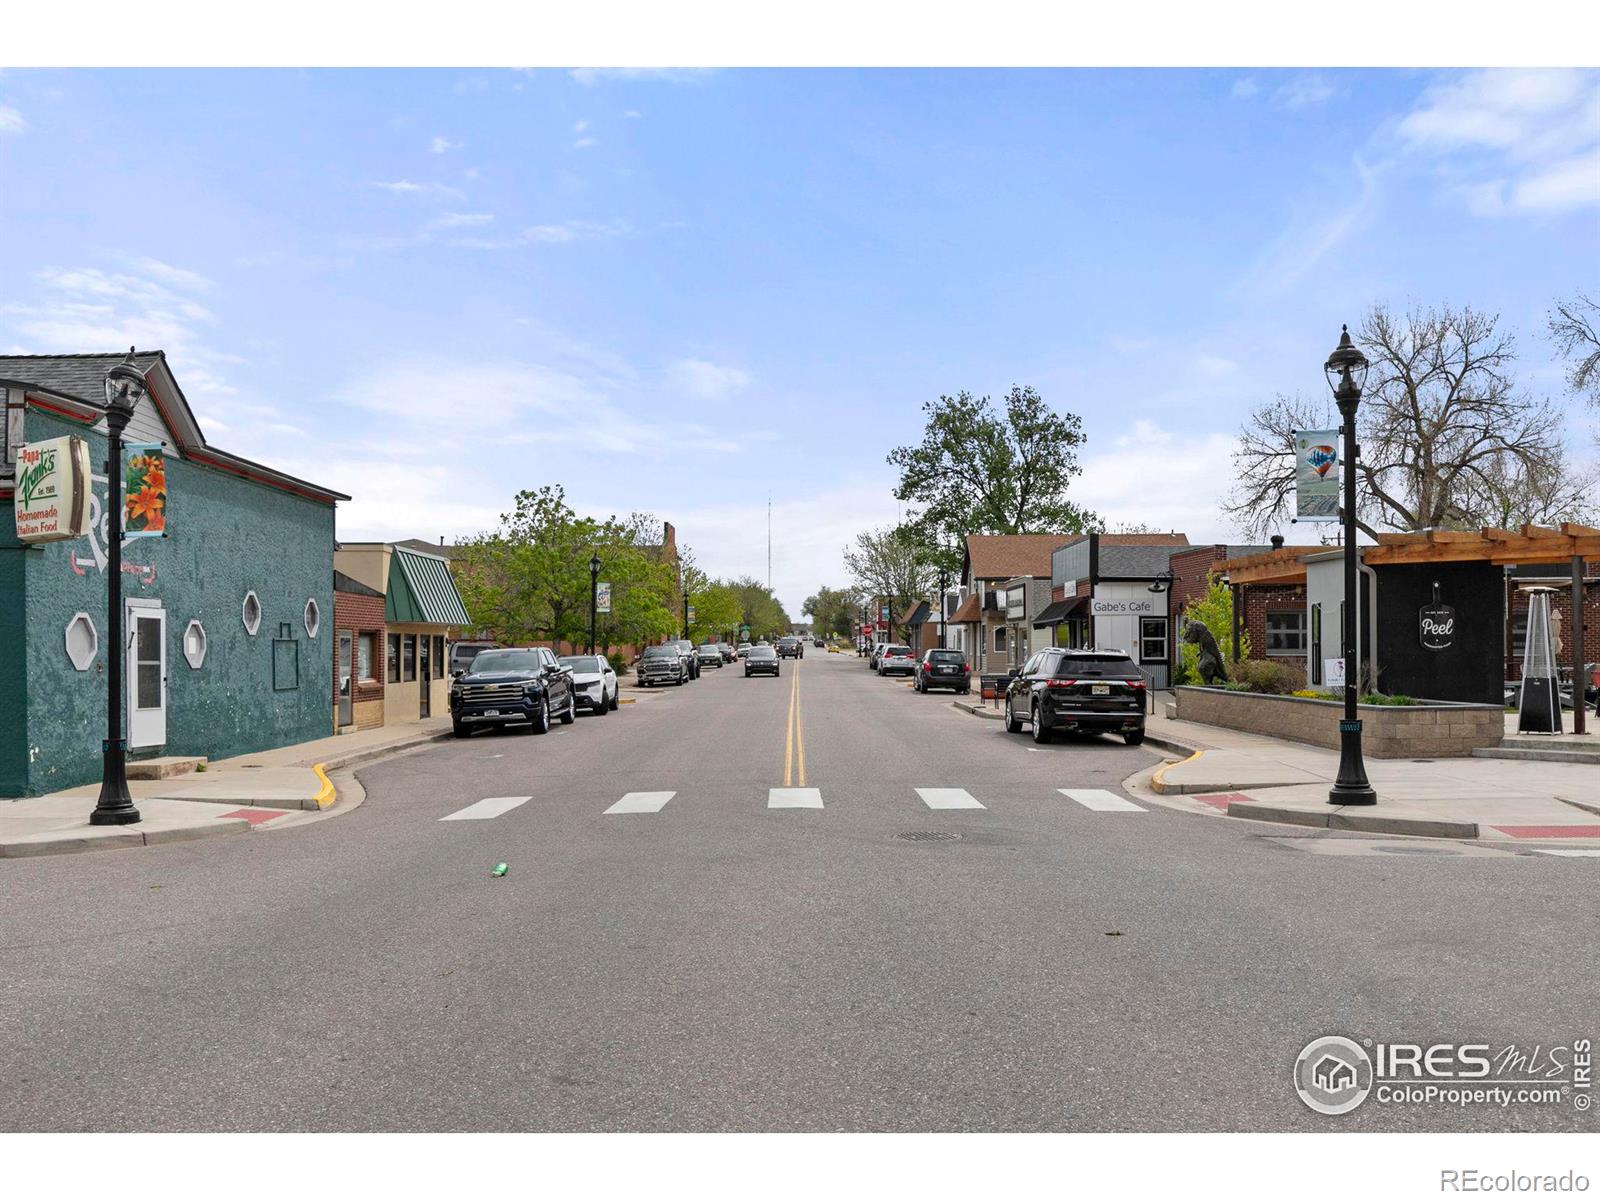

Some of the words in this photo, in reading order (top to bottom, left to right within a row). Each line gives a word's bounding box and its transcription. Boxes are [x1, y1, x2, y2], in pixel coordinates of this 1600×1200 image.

[17, 504, 57, 522] Homemade
[17, 524, 39, 535] Italian
[40, 520, 57, 532] Food
[1094, 602, 1126, 612] Gabe's
[1128, 602, 1151, 612] Cafe
[1422, 618, 1453, 635] Peel
